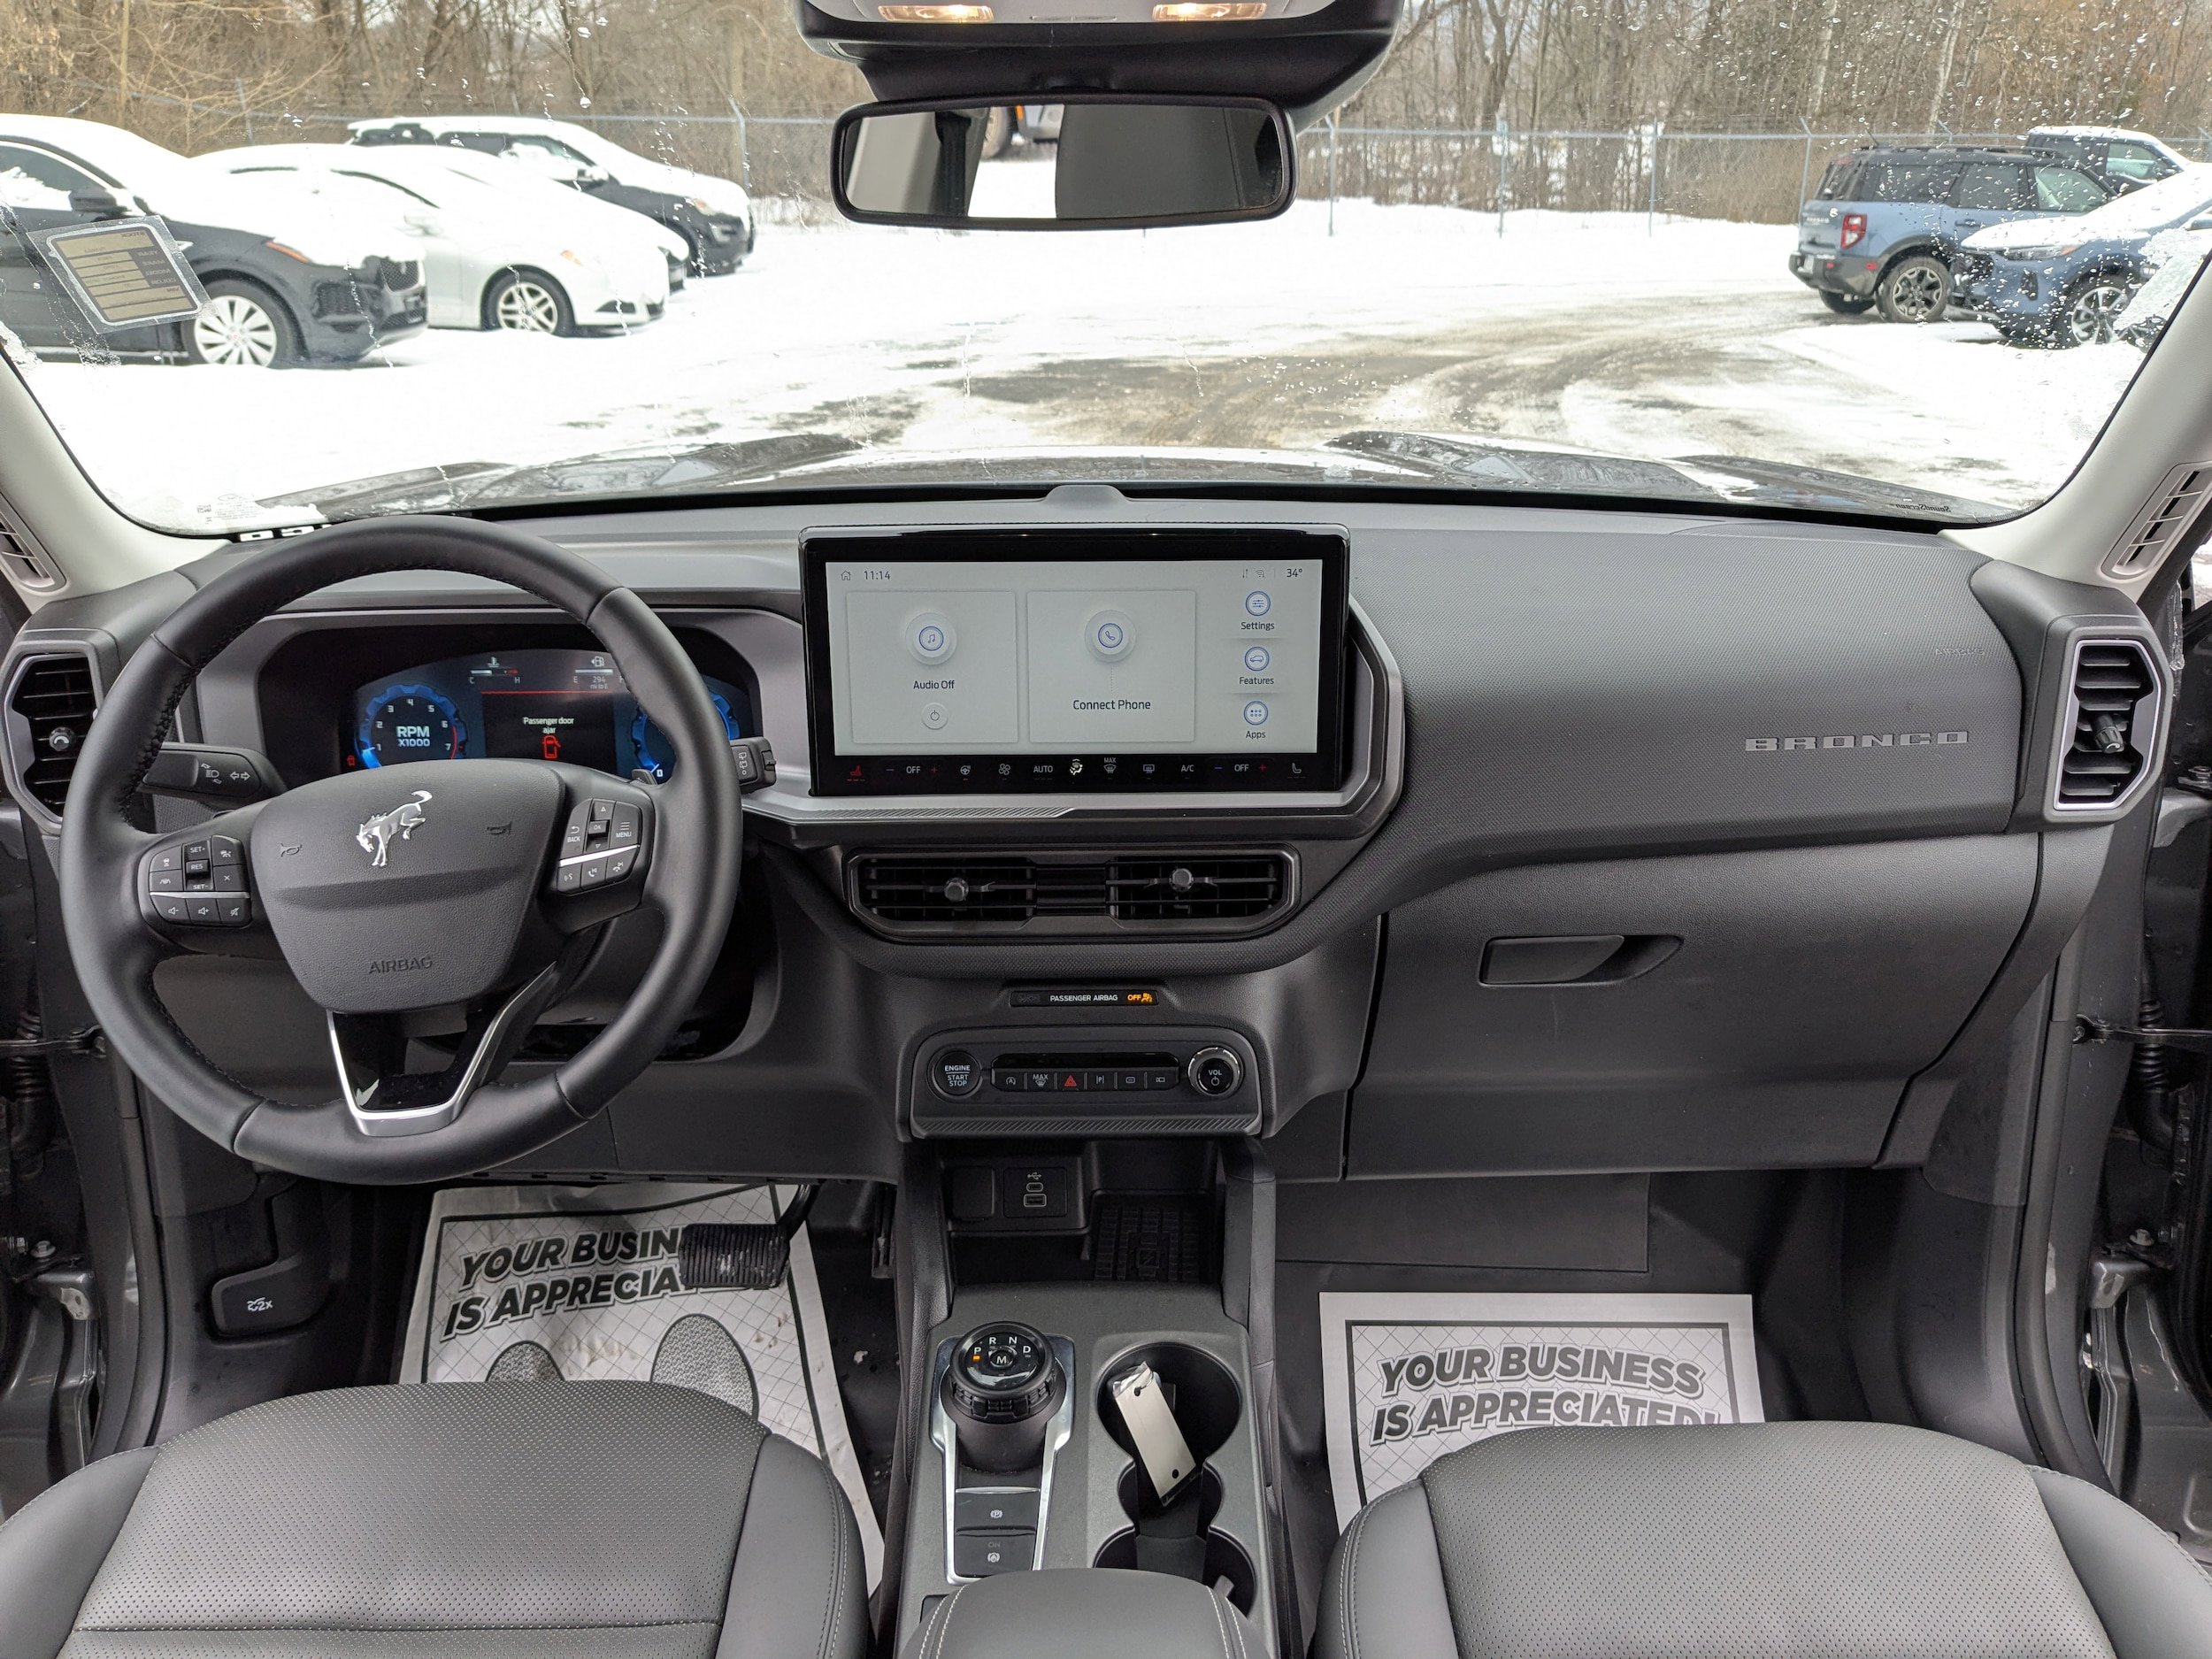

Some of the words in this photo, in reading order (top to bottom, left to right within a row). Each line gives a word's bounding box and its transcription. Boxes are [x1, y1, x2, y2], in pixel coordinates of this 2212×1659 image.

[864, 570, 891, 580] 11:14
[1286, 567, 1303, 579] 34°
[1240, 621, 1275, 631] Settings
[1934, 647, 1985, 657] AIRBAG
[913, 680, 940, 690] Audio
[941, 680, 956, 689] Off
[1239, 676, 1275, 685] Features
[388, 704, 395, 713] 3
[428, 704, 435, 713] 5
[1072, 699, 1116, 710] Connect
[1118, 699, 1151, 710] Phone
[375, 720, 383, 729] 2
[522, 717, 557, 726] Passenger
[558, 716, 575, 725] door
[396, 726, 431, 738] RPM
[542, 726, 557, 735] ajar
[1246, 730, 1266, 740] Apps
[398, 738, 431, 747] X1000
[1745, 731, 1969, 752] BRONCO
[906, 765, 921, 774] OFF
[1180, 764, 1194, 772] A/C
[1233, 764, 1249, 772] OFF
[368, 956, 433, 975] AIRBAG
[462, 1233, 565, 1286] YOUR
[572, 1228, 680, 1266] BUSIN
[444, 1301, 486, 1337] IS
[490, 1266, 694, 1321] APPRECIA
[988, 1336, 997, 1345] R
[973, 1347, 982, 1356] P
[1023, 1345, 1032, 1354] D
[996, 1356, 1007, 1364] M
[1380, 1348, 1493, 1394] YOUR
[1501, 1345, 1703, 1395] BUSINESS
[1372, 1404, 1414, 1444] IS
